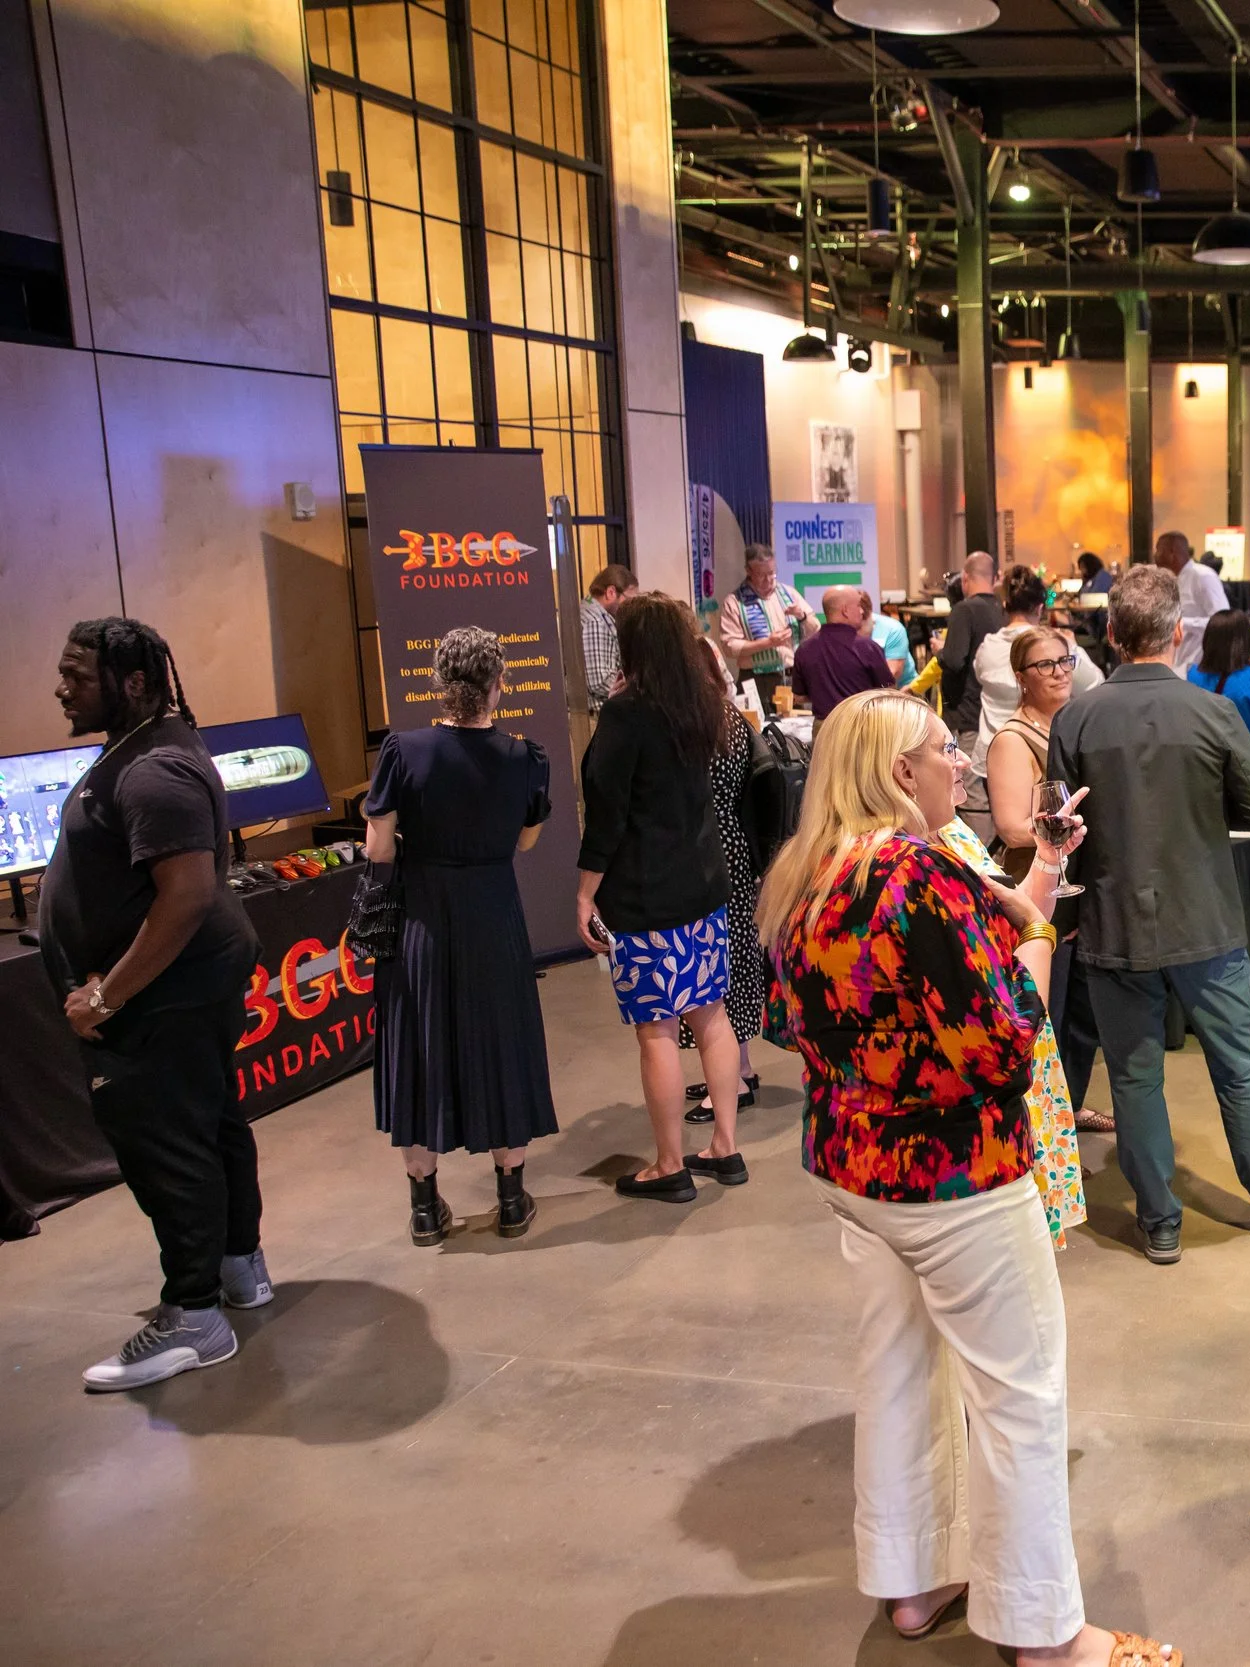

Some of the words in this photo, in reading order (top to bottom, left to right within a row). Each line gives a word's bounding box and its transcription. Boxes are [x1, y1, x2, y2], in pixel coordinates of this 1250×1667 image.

[428, 531, 520, 568] BGG
[802, 540, 864, 566] LEARNING
[400, 571, 529, 590] FOUNDATION
[498, 632, 540, 644] dedicated
[406, 639, 431, 650] BGG
[504, 655, 549, 667] onomically
[400, 668, 411, 677] to
[412, 667, 434, 677] emp
[503, 684, 513, 695] by
[516, 680, 551, 692] utilizing
[405, 691, 446, 703] disadva
[501, 708, 523, 719] them
[524, 707, 533, 716] to
[260, 1286, 269, 1295] 23
